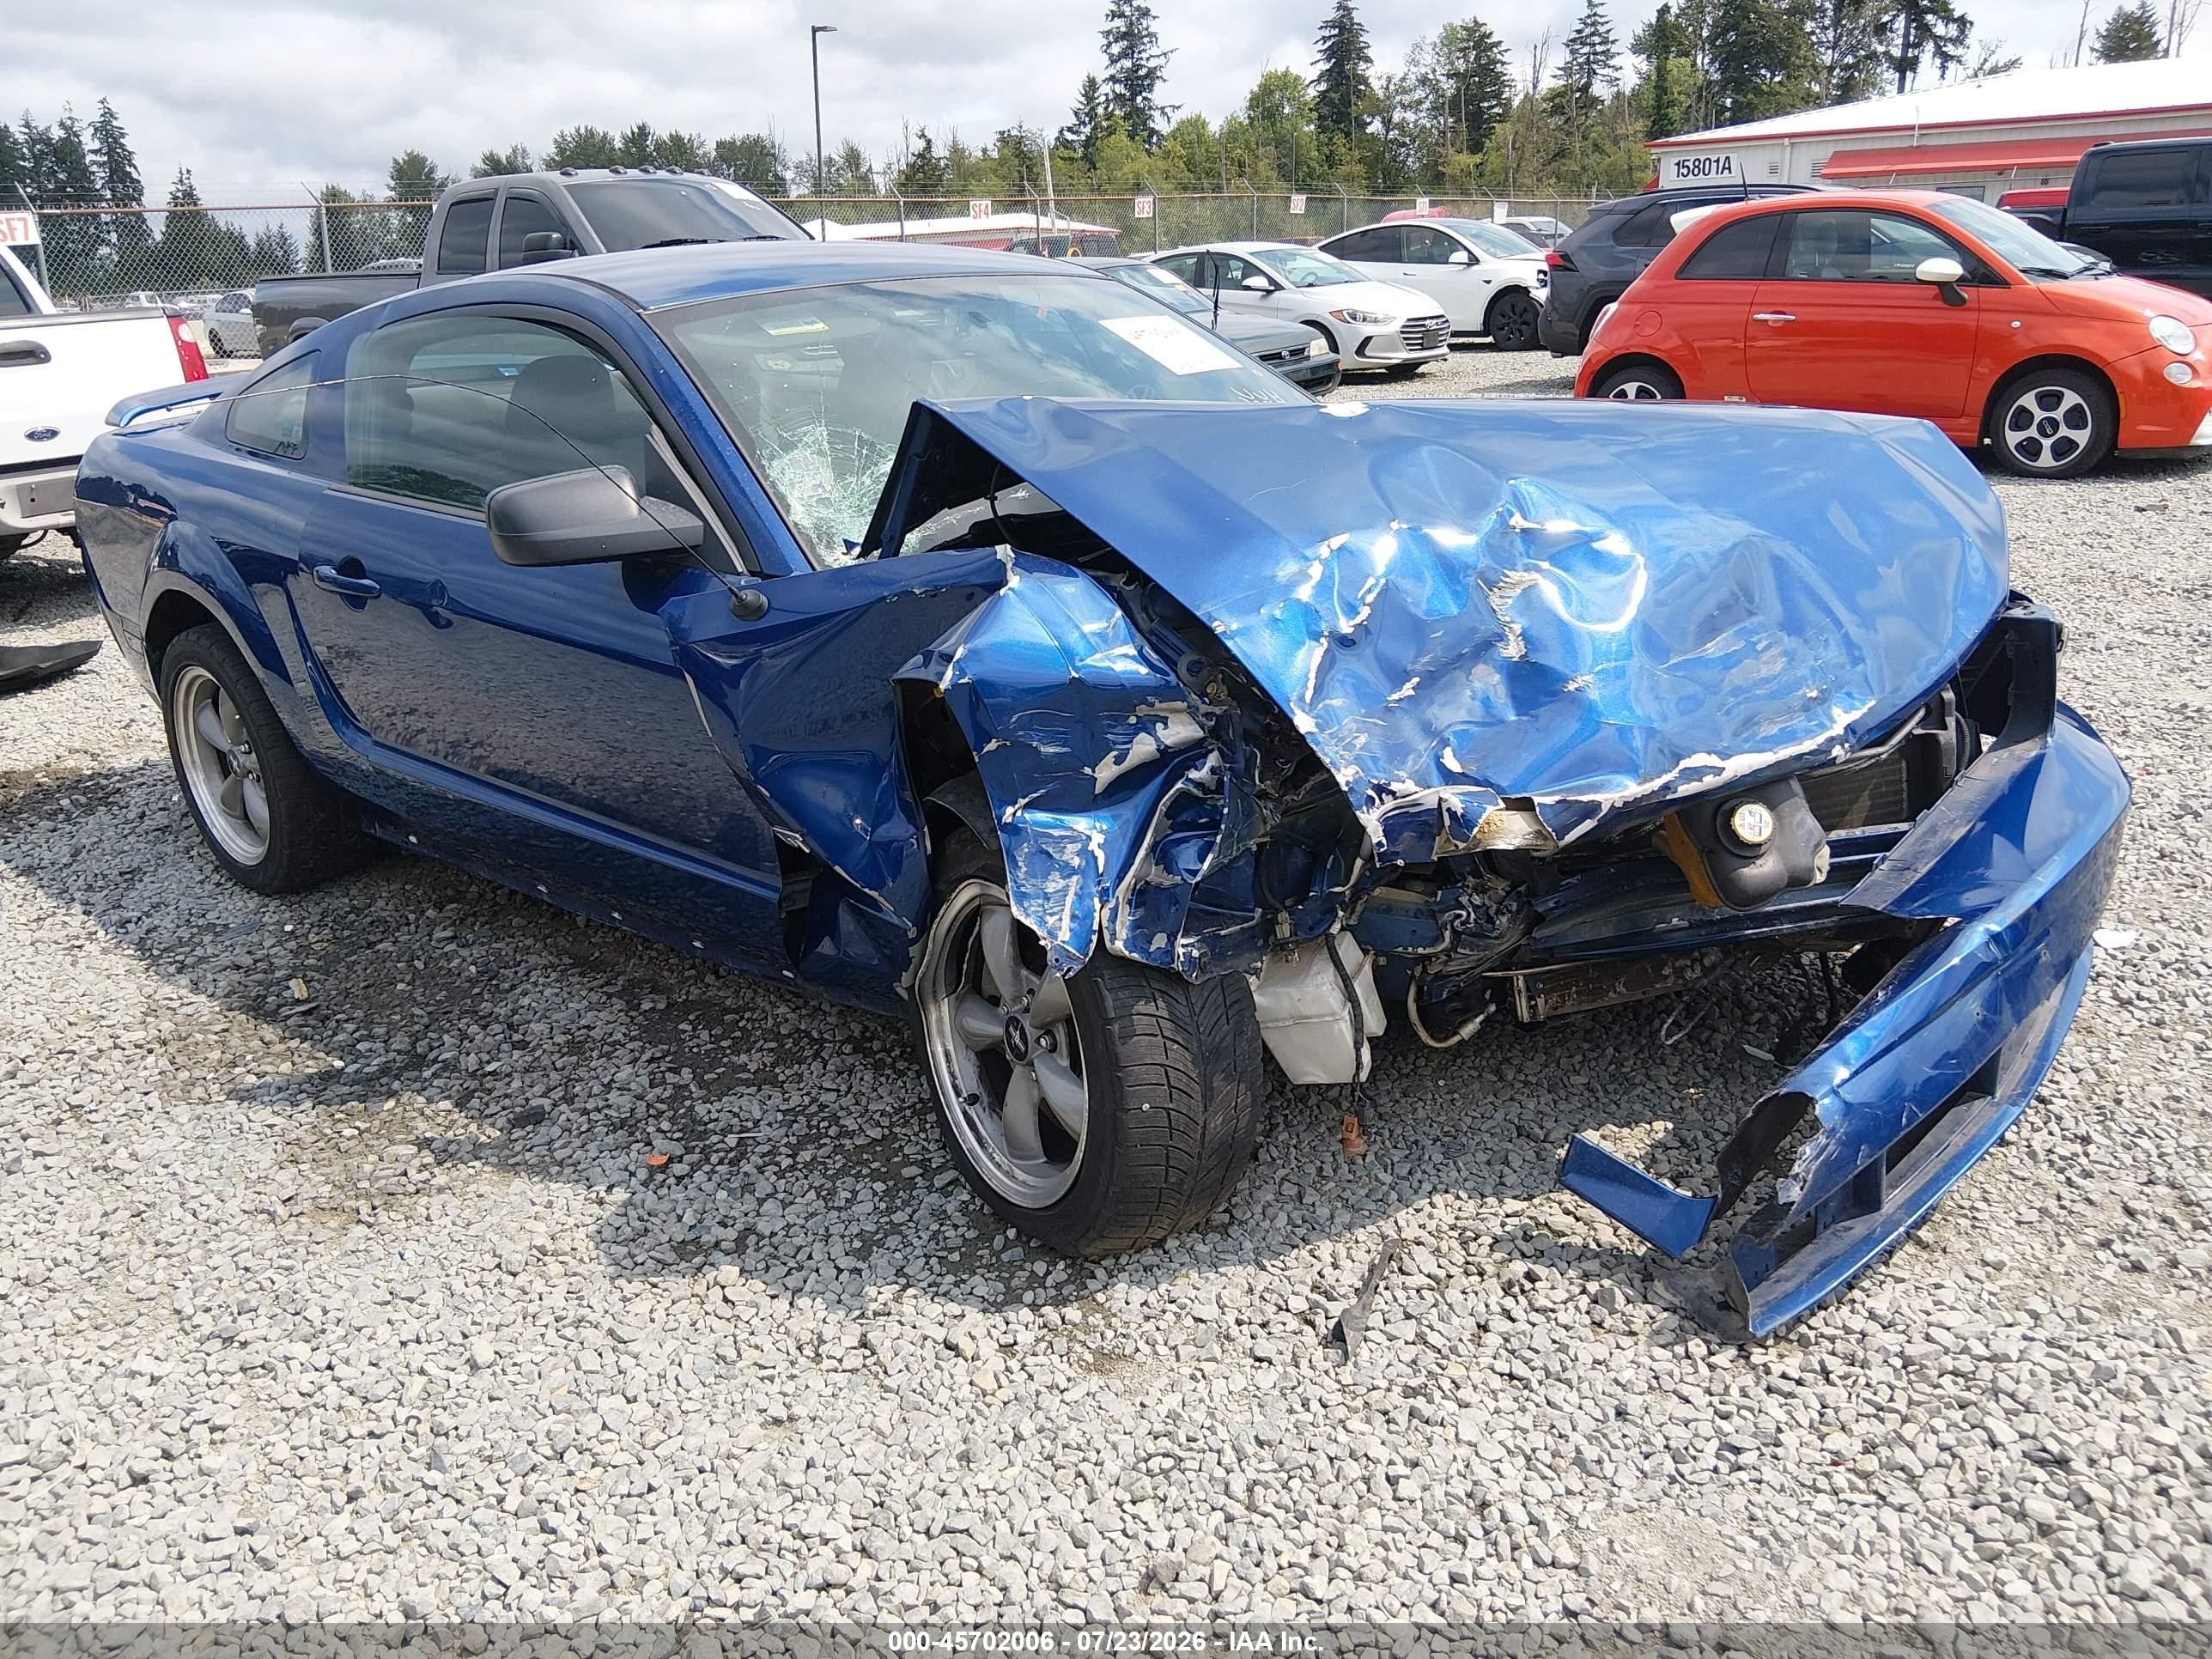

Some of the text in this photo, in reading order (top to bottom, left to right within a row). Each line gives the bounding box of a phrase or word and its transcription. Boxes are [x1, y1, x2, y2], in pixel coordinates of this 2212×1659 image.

[1674, 155, 1732, 179] 15801A
[971, 203, 990, 220] SF4
[1136, 200, 1152, 216] SF3
[1291, 198, 1304, 211] SF2
